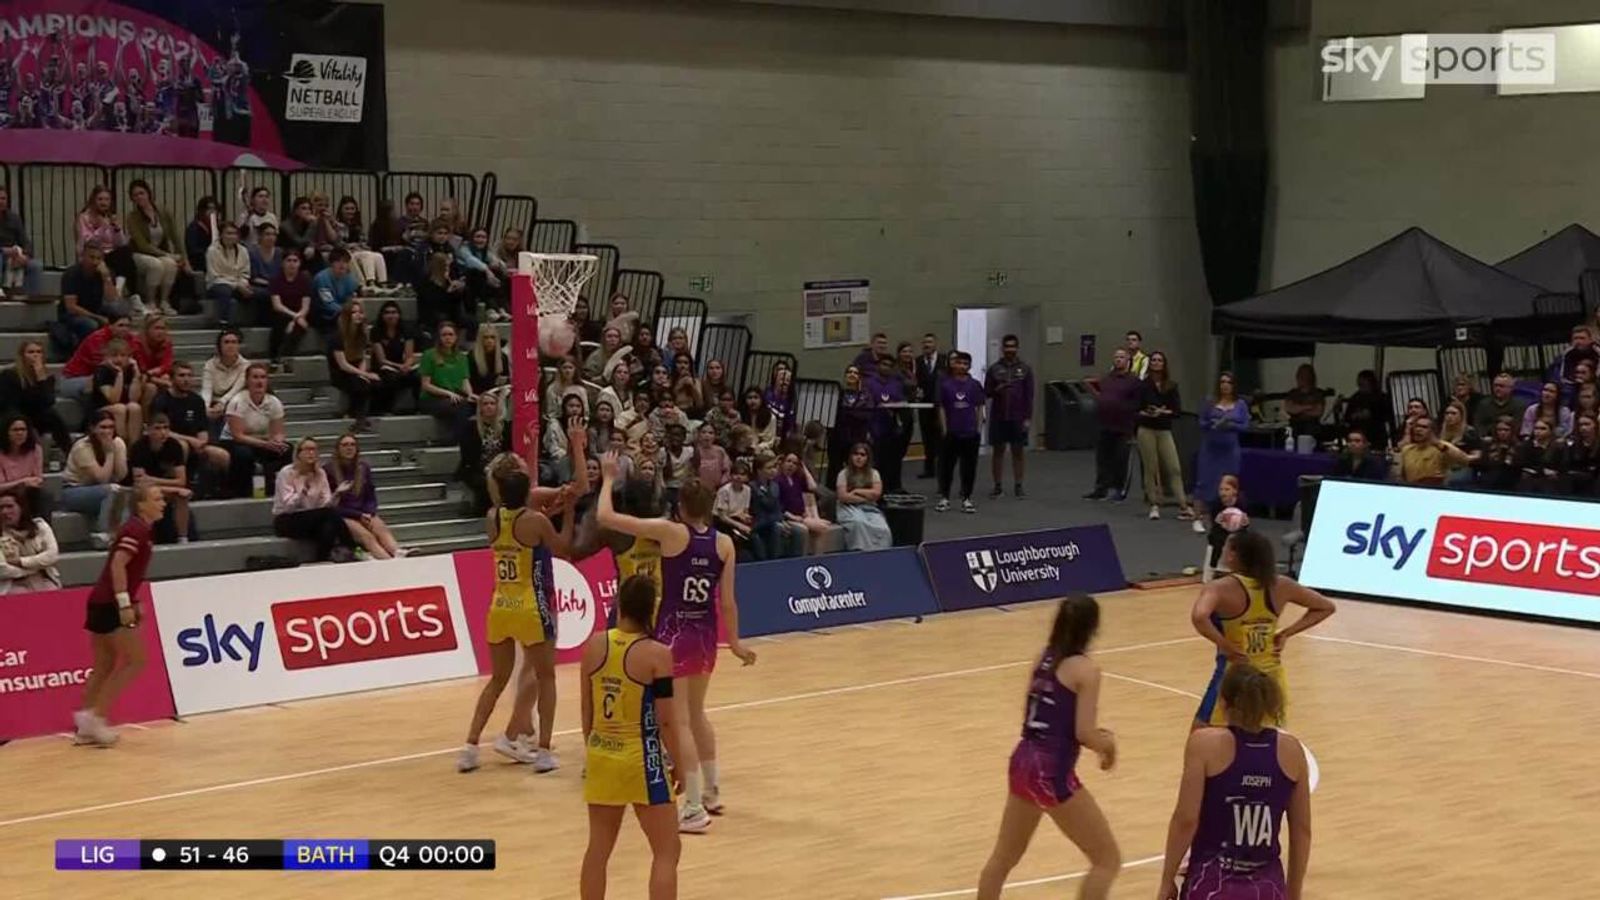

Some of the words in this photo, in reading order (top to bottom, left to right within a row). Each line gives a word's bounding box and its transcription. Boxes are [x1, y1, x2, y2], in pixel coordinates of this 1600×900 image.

[319, 58, 363, 87] Vitality
[290, 88, 359, 106] NETBALL
[995, 541, 1080, 566] Loughborough
[1342, 513, 1426, 570] sky
[1439, 532, 1600, 580] sports
[498, 560, 517, 580] GD
[1000, 564, 1060, 583] University
[683, 576, 711, 603] GS
[788, 589, 867, 618] Computacenter
[177, 613, 264, 672] sky
[286, 600, 444, 660] sports
[603, 693, 616, 720] C
[1241, 774, 1271, 787] JOSEPH
[1233, 803, 1273, 847] WA
